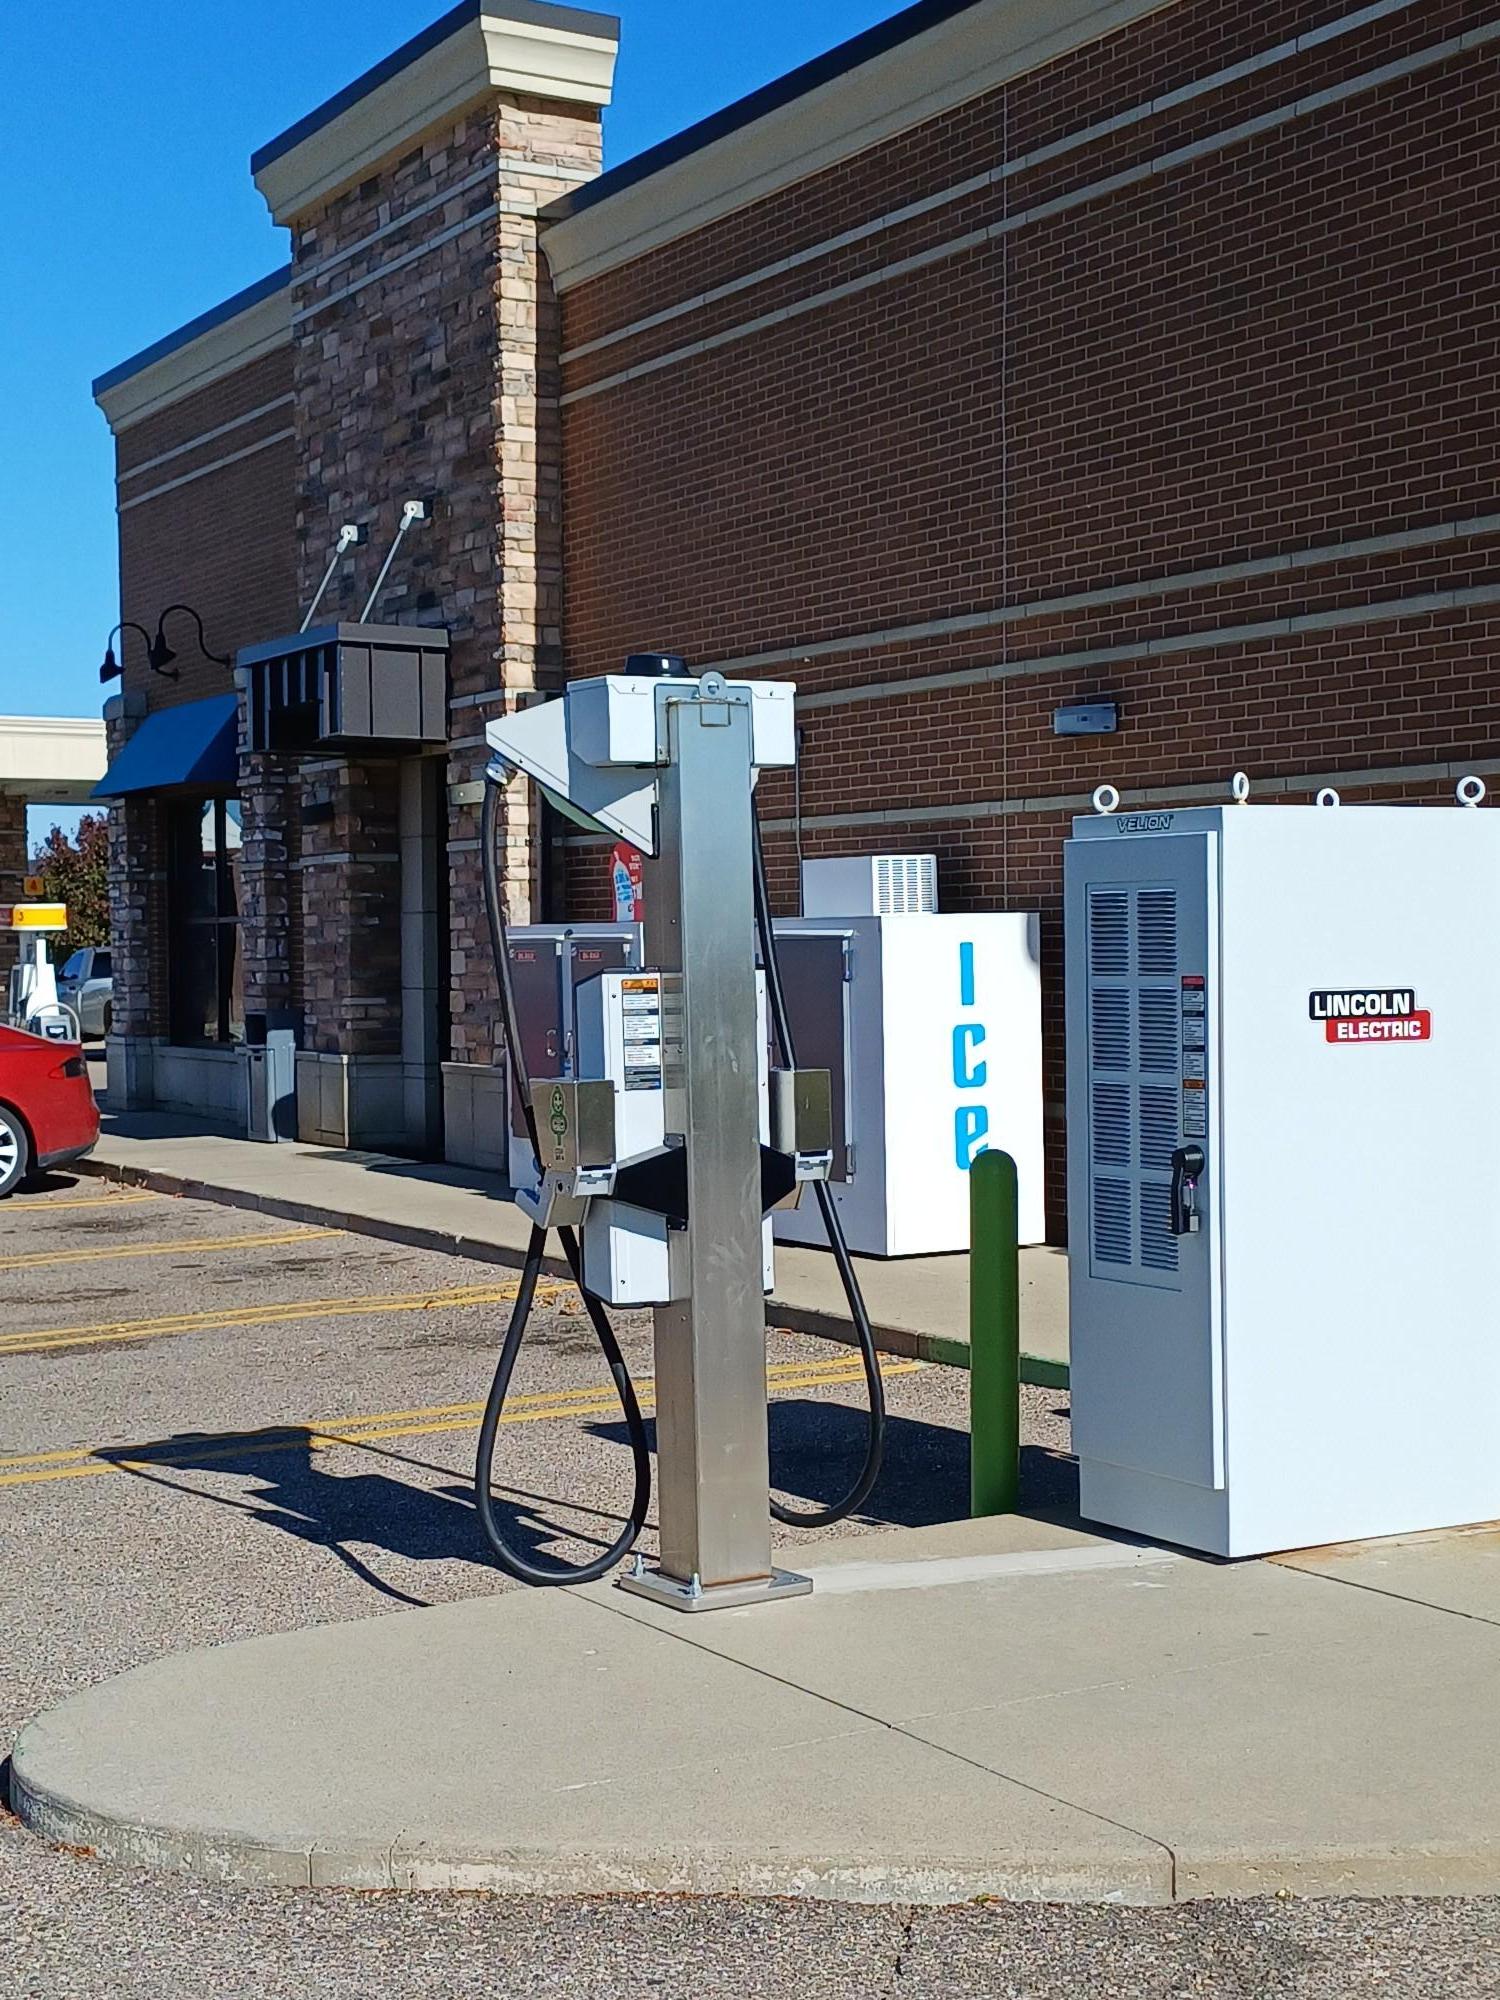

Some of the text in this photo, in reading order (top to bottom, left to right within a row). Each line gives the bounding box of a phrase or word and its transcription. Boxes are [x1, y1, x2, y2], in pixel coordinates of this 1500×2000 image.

[1117, 815, 1171, 833] VELION
[1314, 993, 1410, 1017] LINCOLN
[1337, 1020, 1421, 1039] ELECTRIC
